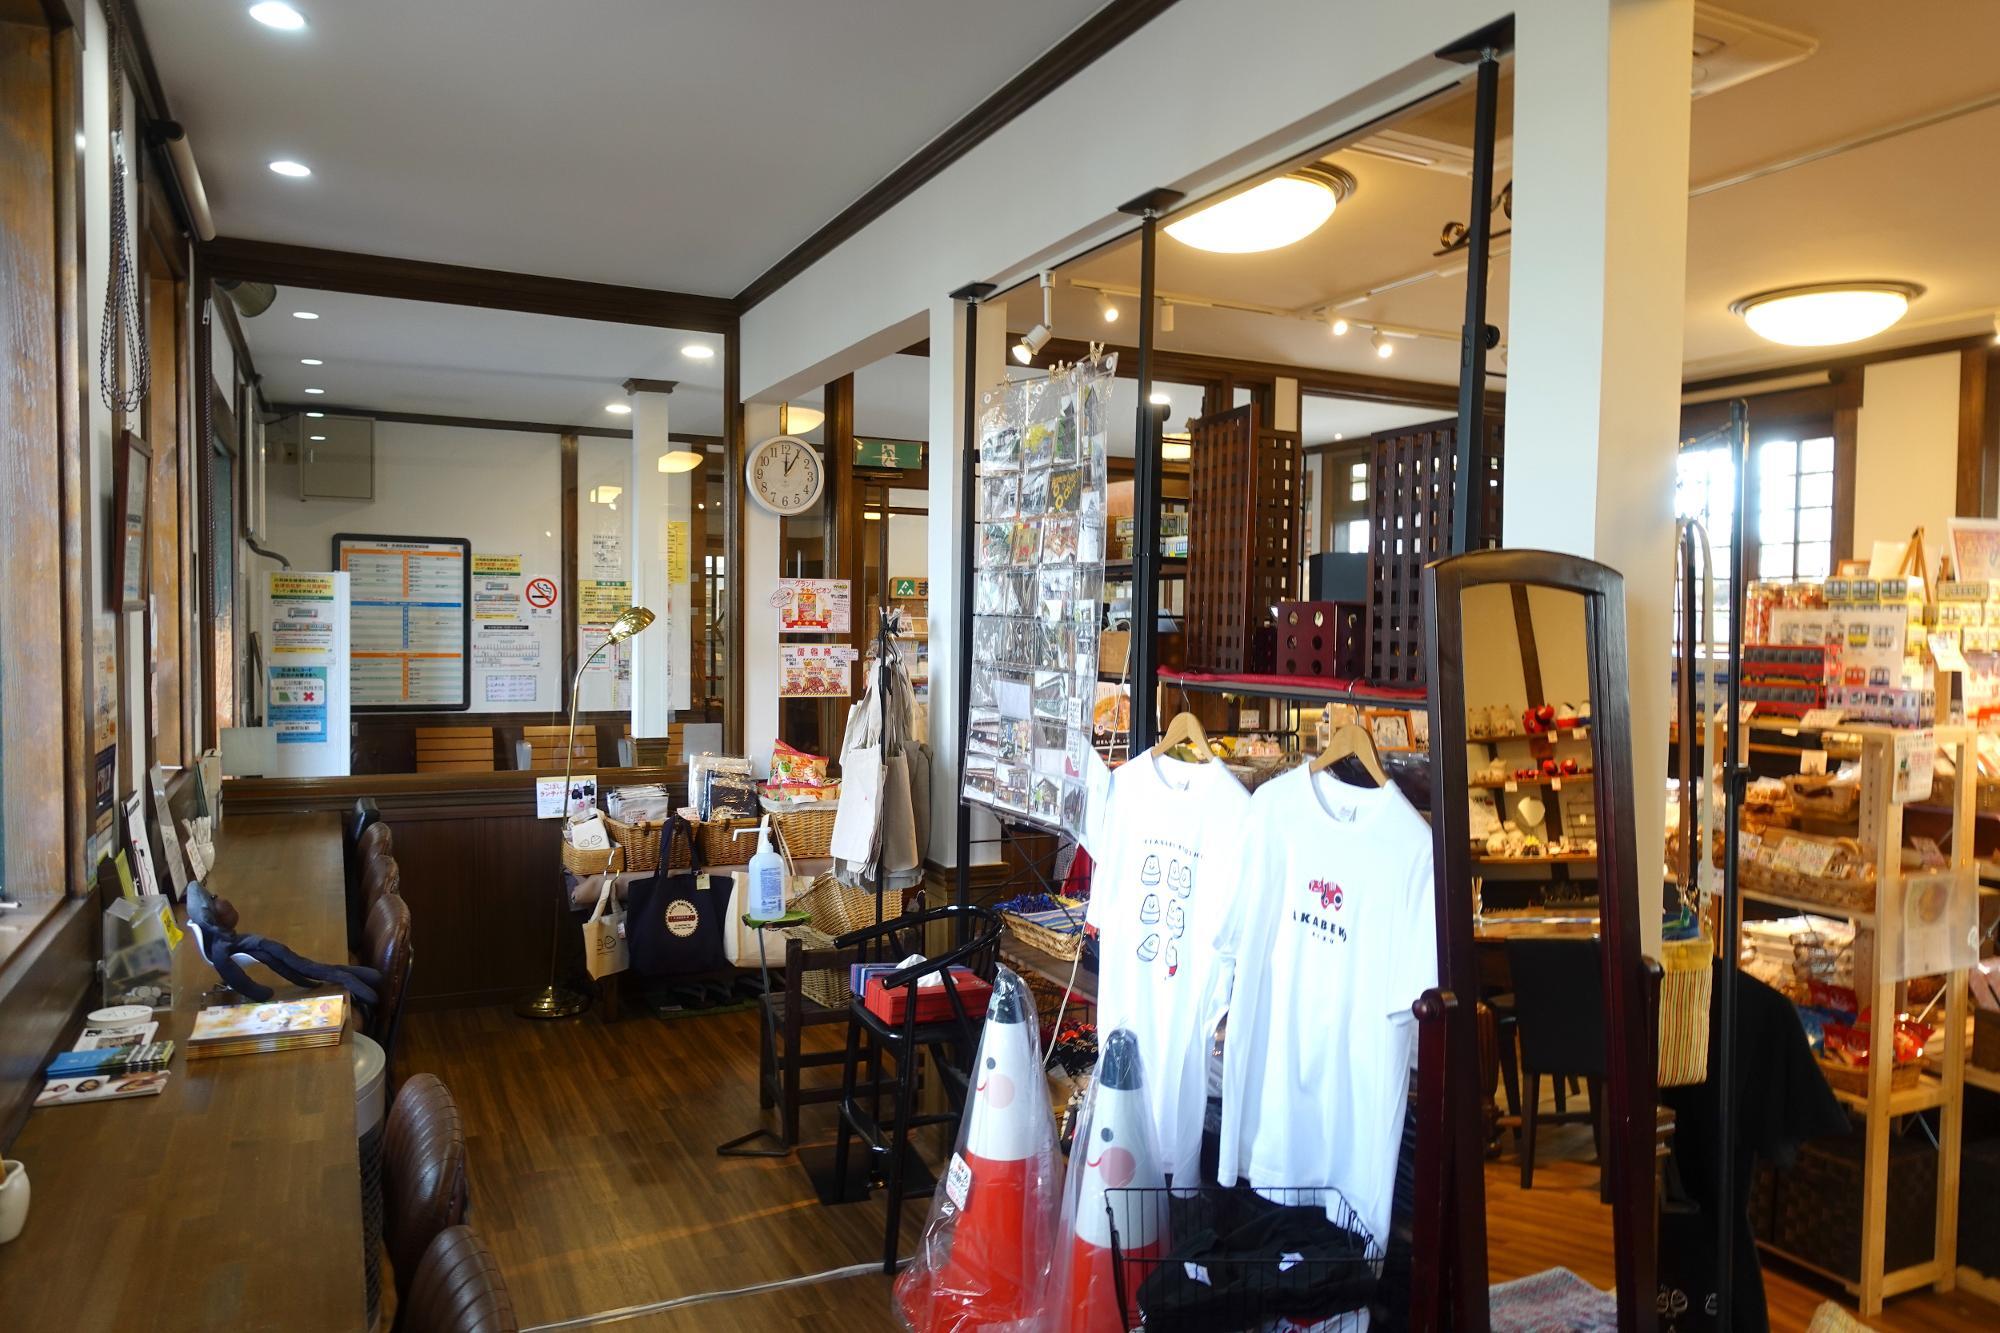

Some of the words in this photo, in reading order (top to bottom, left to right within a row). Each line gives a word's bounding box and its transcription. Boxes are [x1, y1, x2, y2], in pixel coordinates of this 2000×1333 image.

[770, 447, 778, 458] 11
[781, 444, 791, 455] 12
[760, 455, 770, 467] 10
[804, 459, 810, 469] 2
[757, 469, 763, 479] 9
[807, 471, 814, 482] 3
[761, 482, 768, 493] 8
[803, 485, 809, 495] 4
[770, 492, 776, 502] 7
[782, 496, 789, 506] 6
[794, 493, 800, 504] 5
